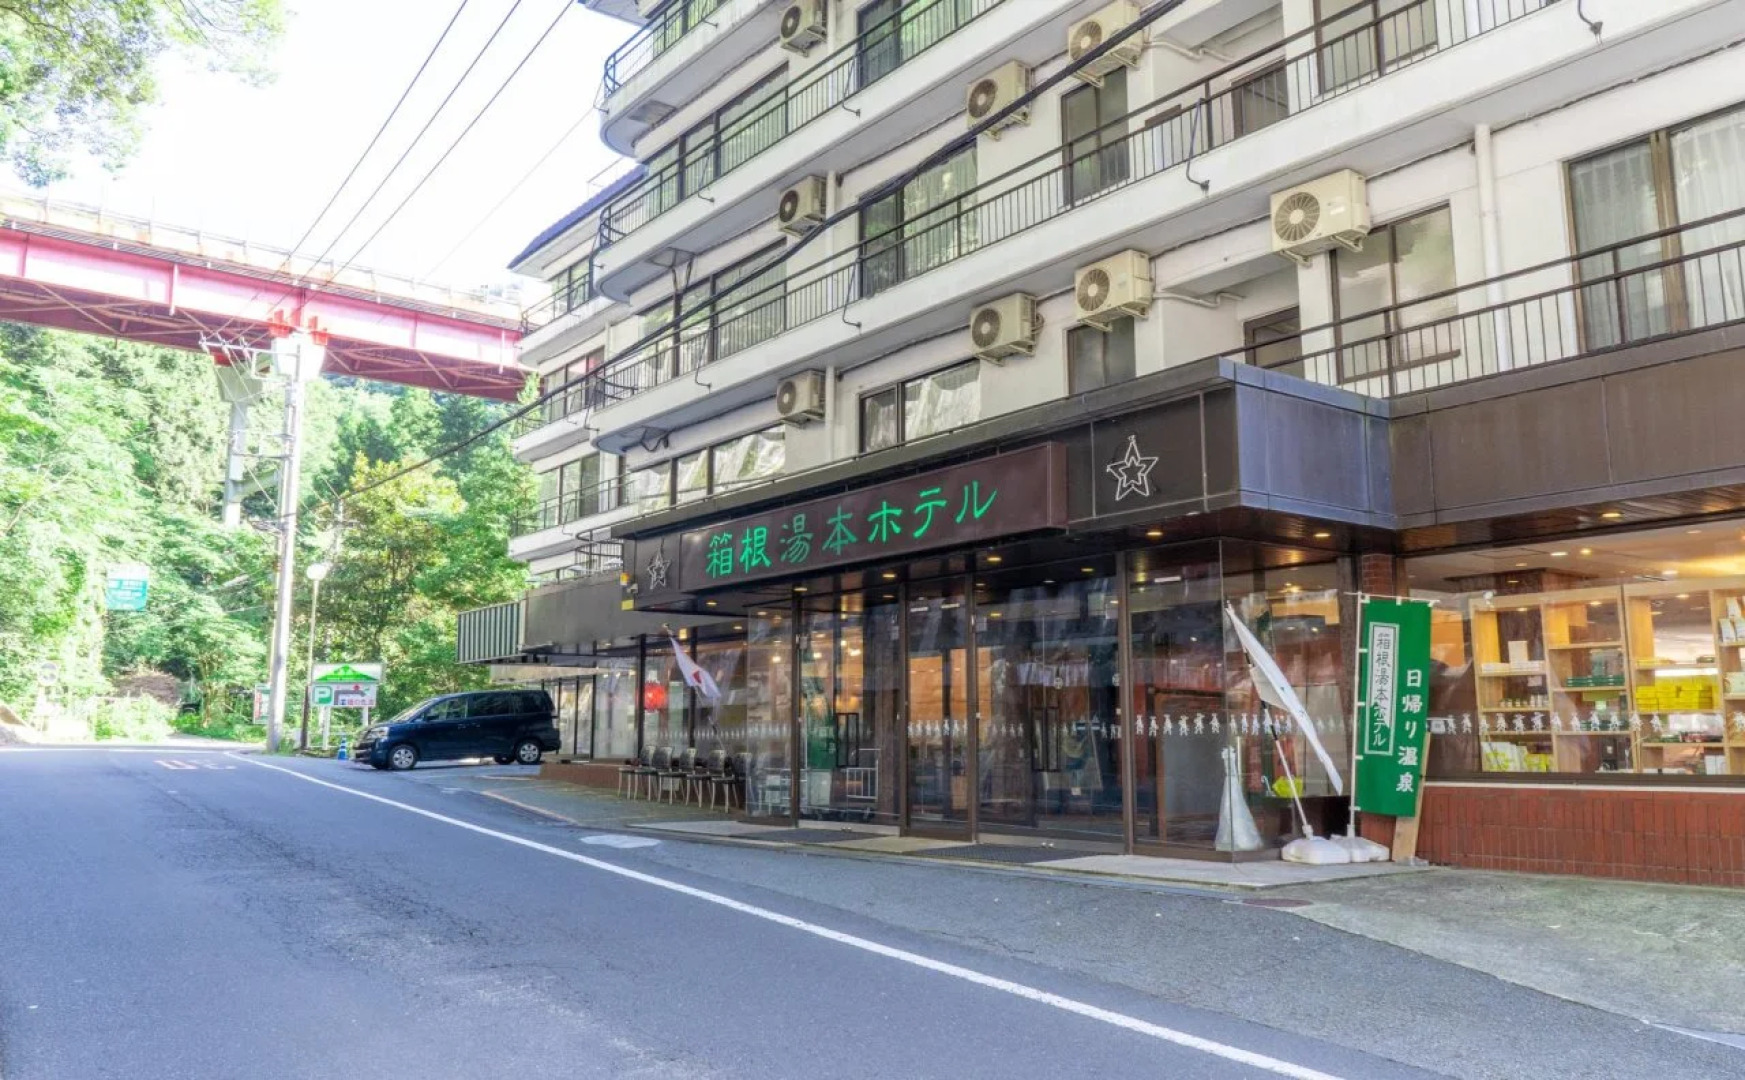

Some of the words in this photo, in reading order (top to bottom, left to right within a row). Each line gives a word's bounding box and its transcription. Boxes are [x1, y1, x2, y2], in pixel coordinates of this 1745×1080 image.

[705, 480, 998, 579] 箱根湯本ホテル
[314, 686, 331, 704] P
[1373, 632, 1391, 747] 箱根湯本ホテル
[1396, 669, 1423, 793] 日帰り温泉
